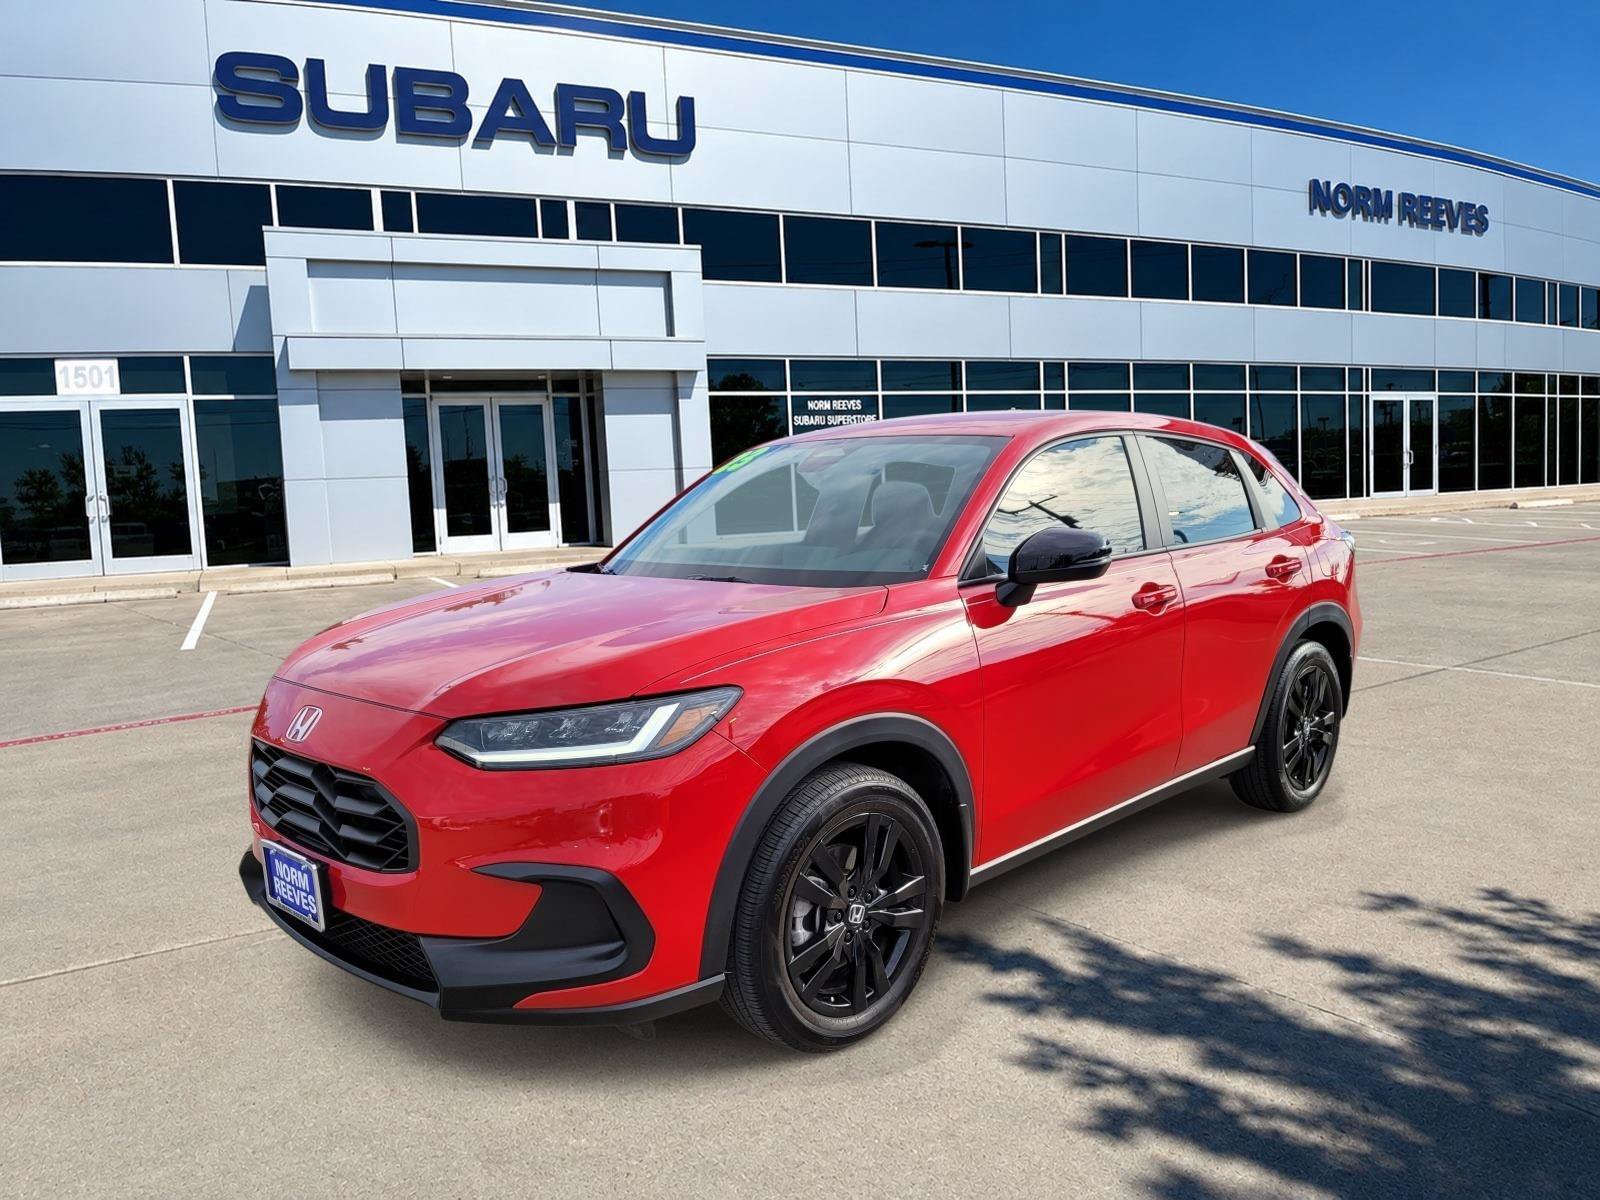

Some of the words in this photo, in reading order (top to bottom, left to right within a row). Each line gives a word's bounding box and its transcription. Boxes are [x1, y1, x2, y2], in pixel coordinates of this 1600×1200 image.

[214, 50, 696, 155] SUBARU
[1309, 178, 1393, 221] NORM
[1398, 192, 1489, 234] REEVES
[58, 364, 115, 389] 1501
[793, 414, 826, 426] SUBARU
[807, 399, 830, 411] NORM
[832, 399, 862, 411] REEVES
[274, 858, 310, 893] NORM
[272, 875, 317, 914] REEVES
